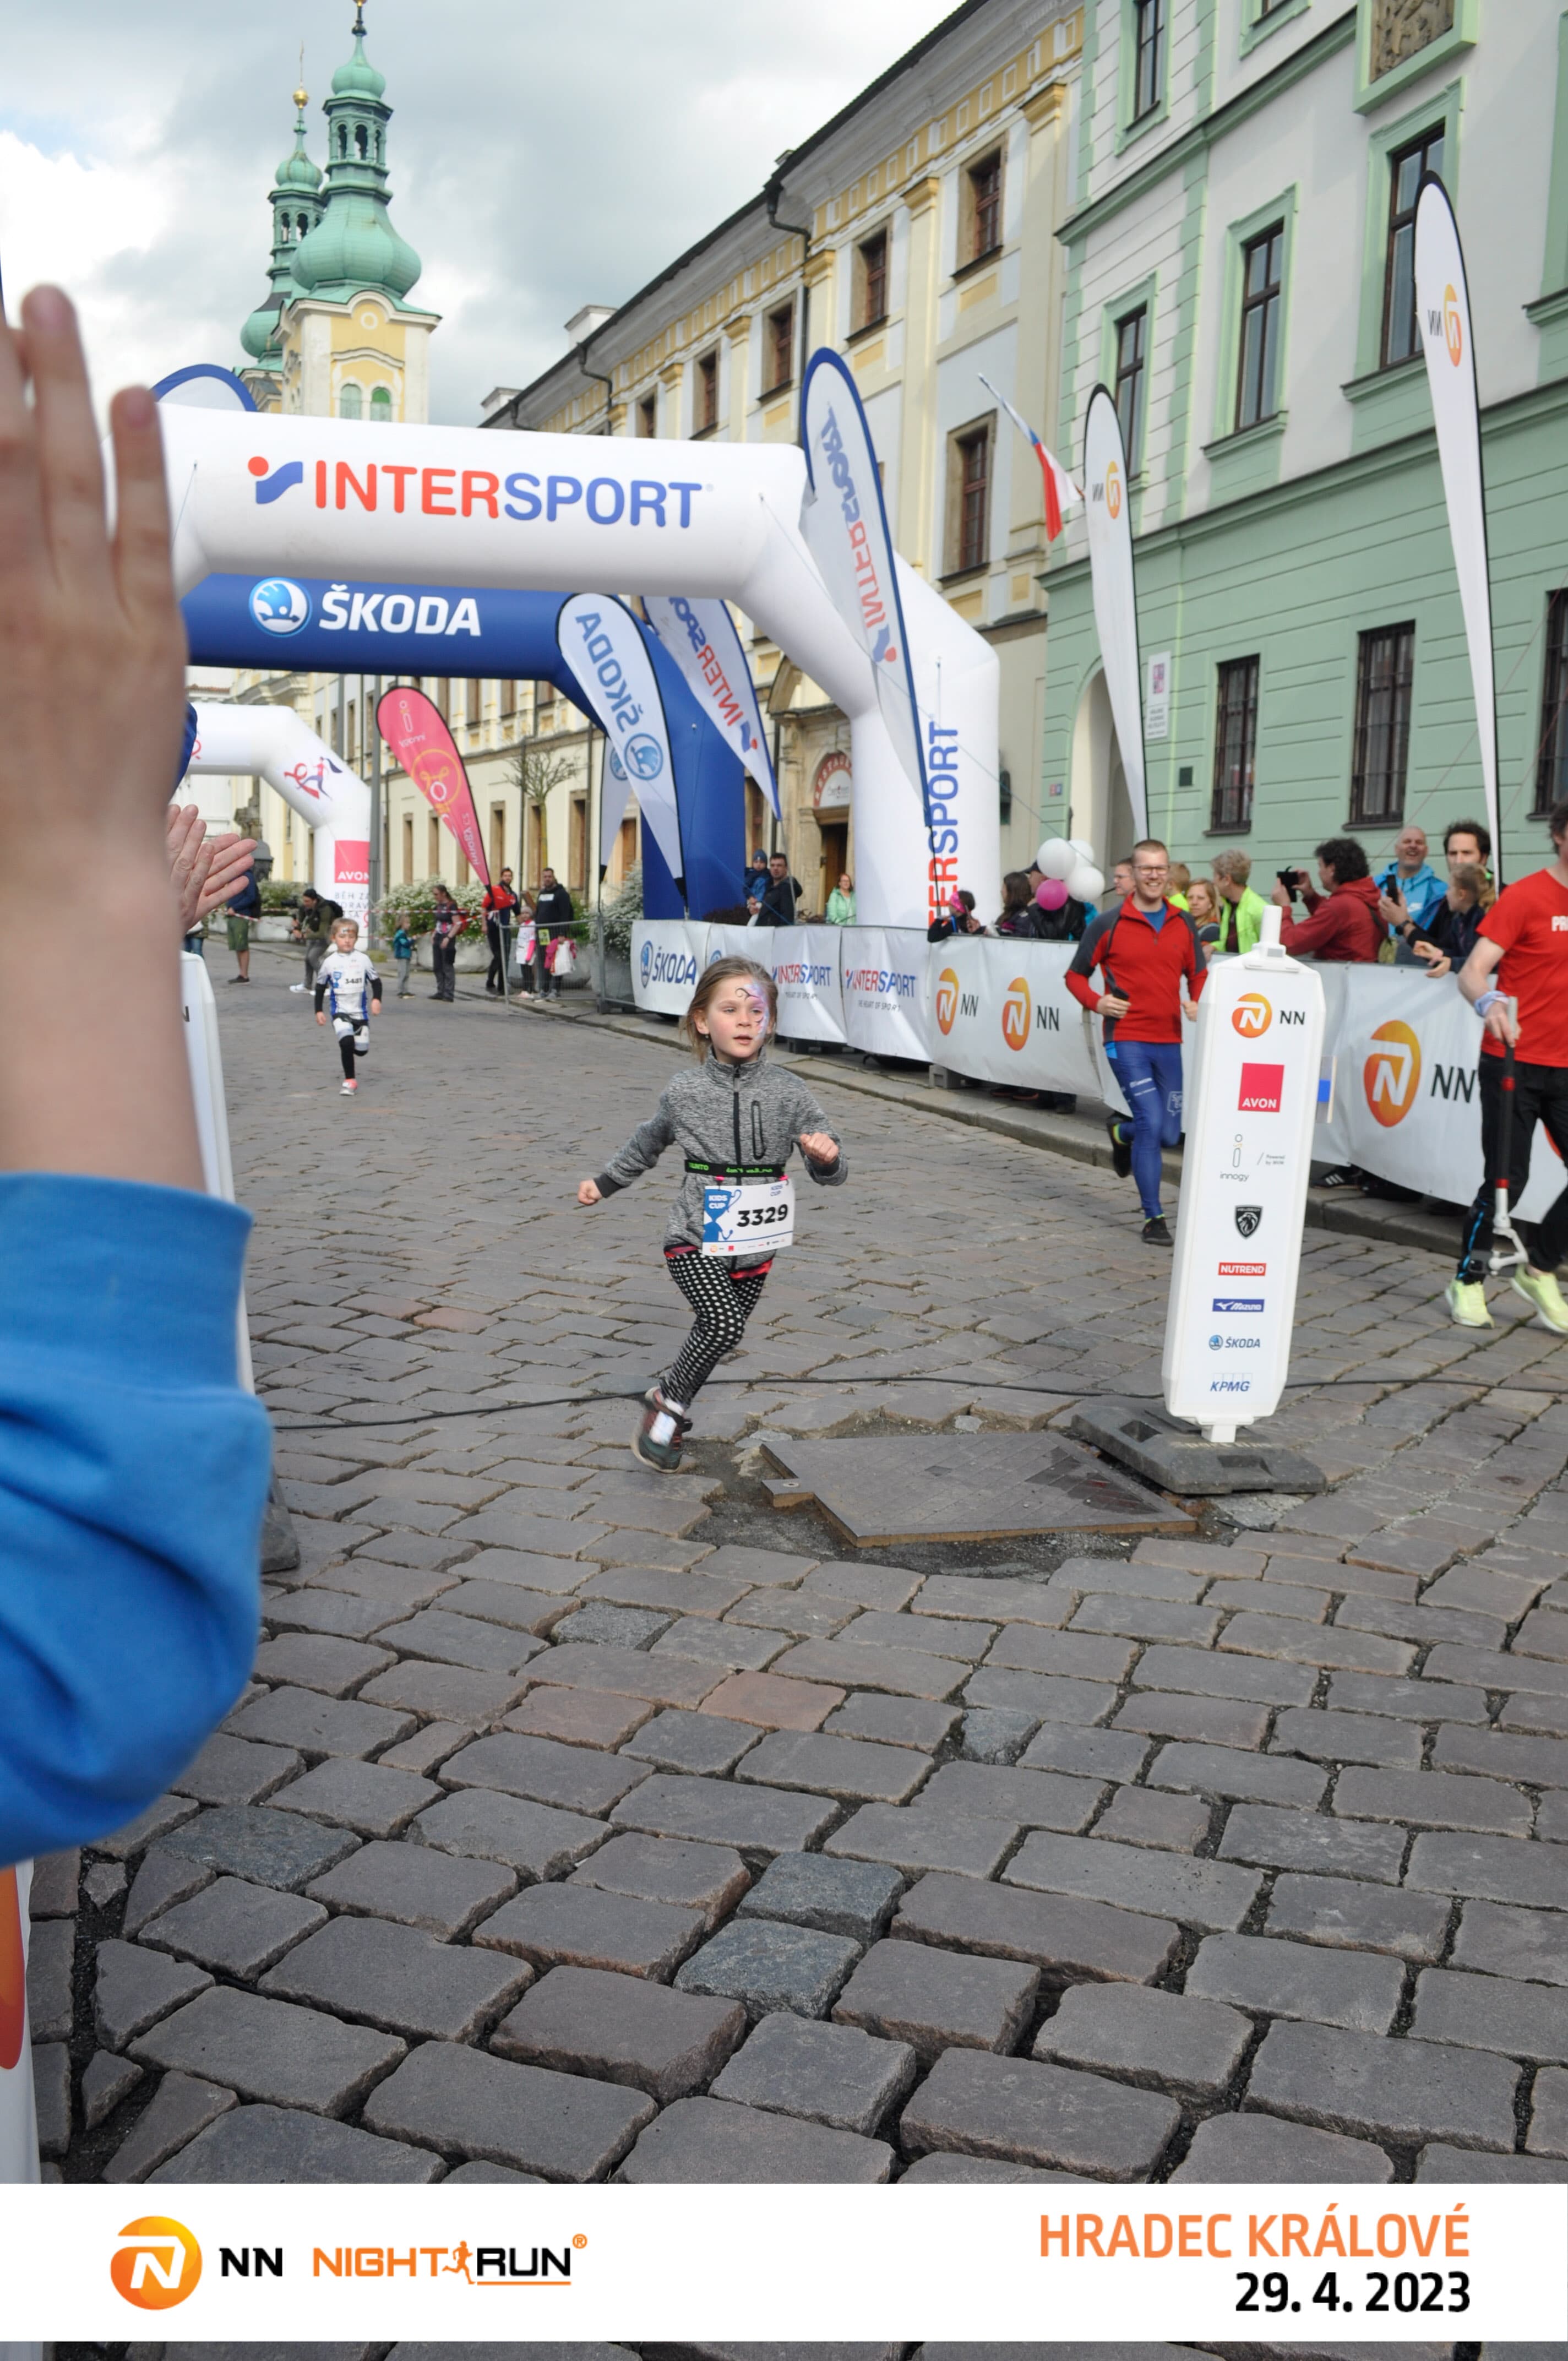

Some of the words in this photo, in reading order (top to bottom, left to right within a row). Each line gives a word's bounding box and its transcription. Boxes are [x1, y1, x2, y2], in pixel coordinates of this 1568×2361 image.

[315, 460, 703, 529] INTERSPORT
[319, 584, 481, 637] ŠKODA
[652, 946, 697, 986] ŠKODA
[961, 993, 979, 1017] NN
[1037, 1005, 1060, 1031] NN
[1280, 1010, 1306, 1025] NN
[1431, 1064, 1478, 1103] NN
[1242, 1097, 1277, 1109] AVON
[1219, 1171, 1250, 1182] innogy
[737, 1204, 789, 1227] 3329
[1220, 1265, 1265, 1274] NUTREND
[1225, 1336, 1261, 1348] ŠKODA
[1210, 1380, 1250, 1392] KPMG
